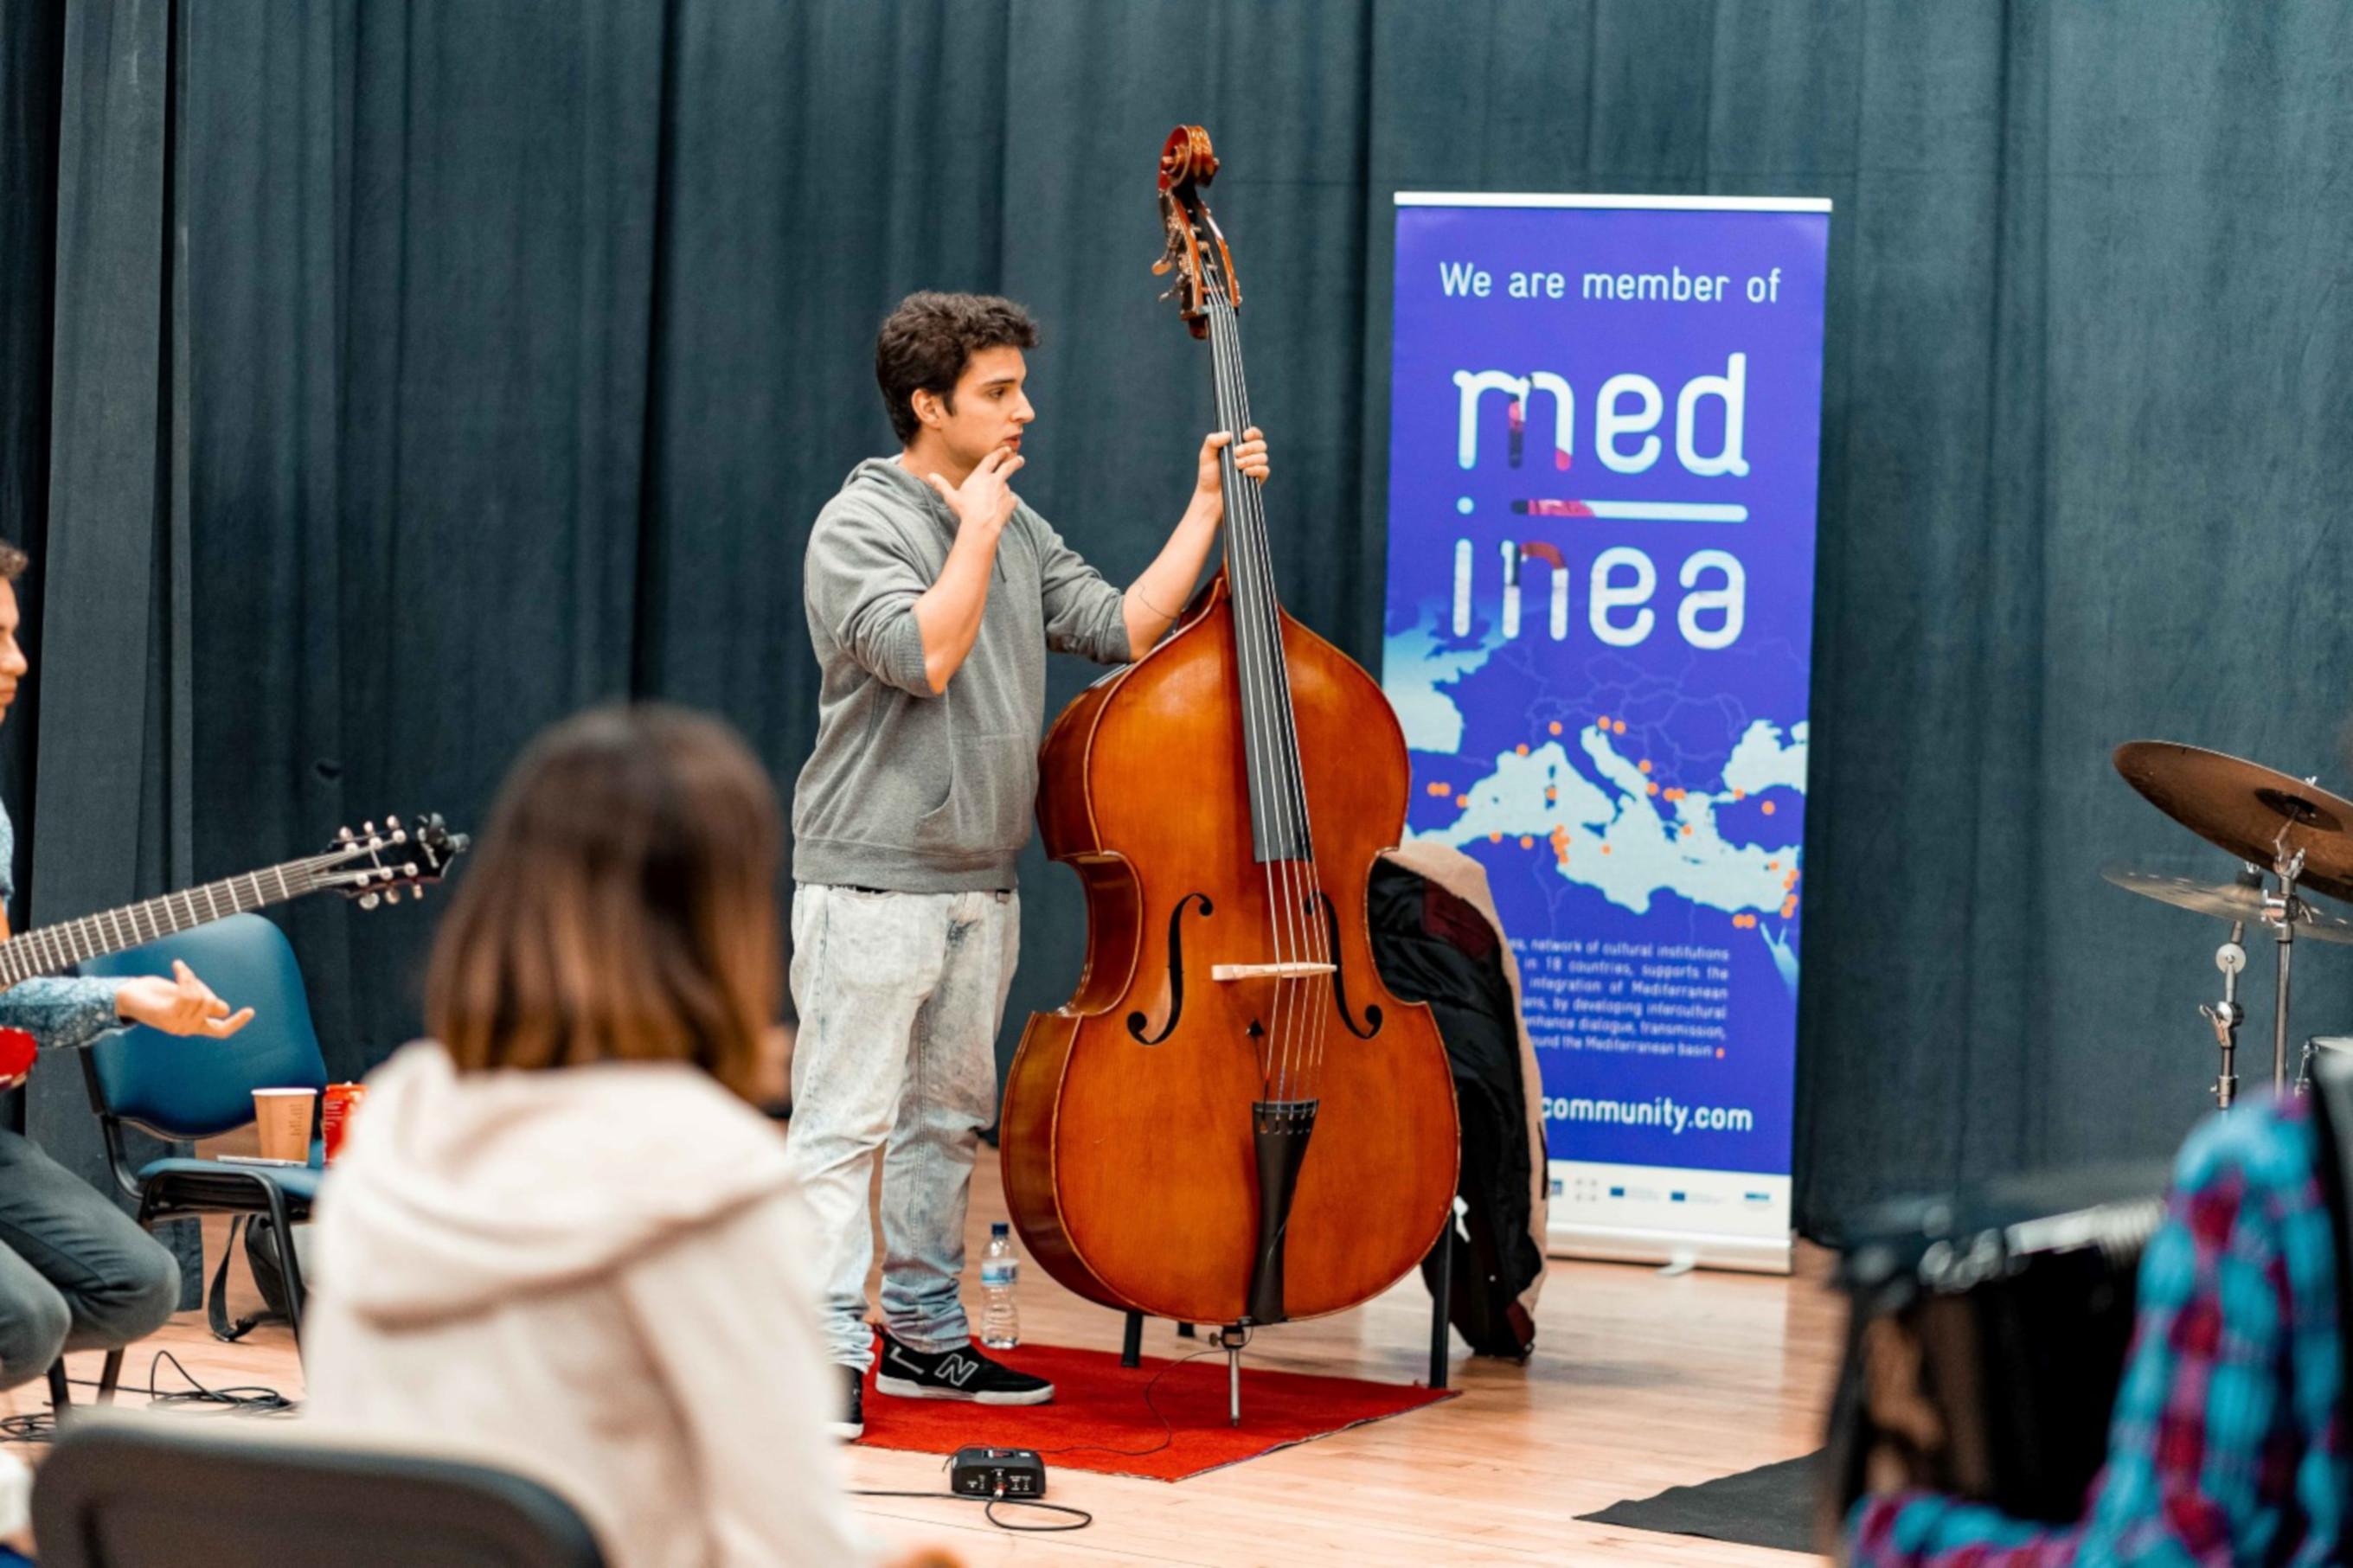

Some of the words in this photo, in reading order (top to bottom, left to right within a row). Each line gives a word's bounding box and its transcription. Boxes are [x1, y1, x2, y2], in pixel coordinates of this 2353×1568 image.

[1439, 261, 1492, 298] We
[1508, 272, 1565, 298] are
[1582, 266, 1730, 303] member
[1747, 267, 1781, 303] of
[1452, 352, 1750, 477] med
[1452, 497, 1747, 650] inea
[1530, 939, 1582, 953] network
[1586, 940, 1600, 955] of
[1602, 942, 1652, 957] cultural
[1657, 945, 1728, 962] institutions
[1524, 957, 1537, 970] in
[1568, 961, 1633, 977] countries,
[1641, 964, 1699, 980] supports
[1708, 966, 1728, 981] the
[1529, 976, 1601, 995] integration
[1610, 980, 1623, 995] of
[1632, 981, 1728, 999] Mediterranean
[1554, 997, 1568, 1014] by
[1573, 999, 1642, 1019] developing
[1647, 1002, 1727, 1020] intercultural
[1562, 1035, 1582, 1050] the
[1586, 1036, 1676, 1054] Mediterranean
[1678, 1041, 1712, 1057] basin
